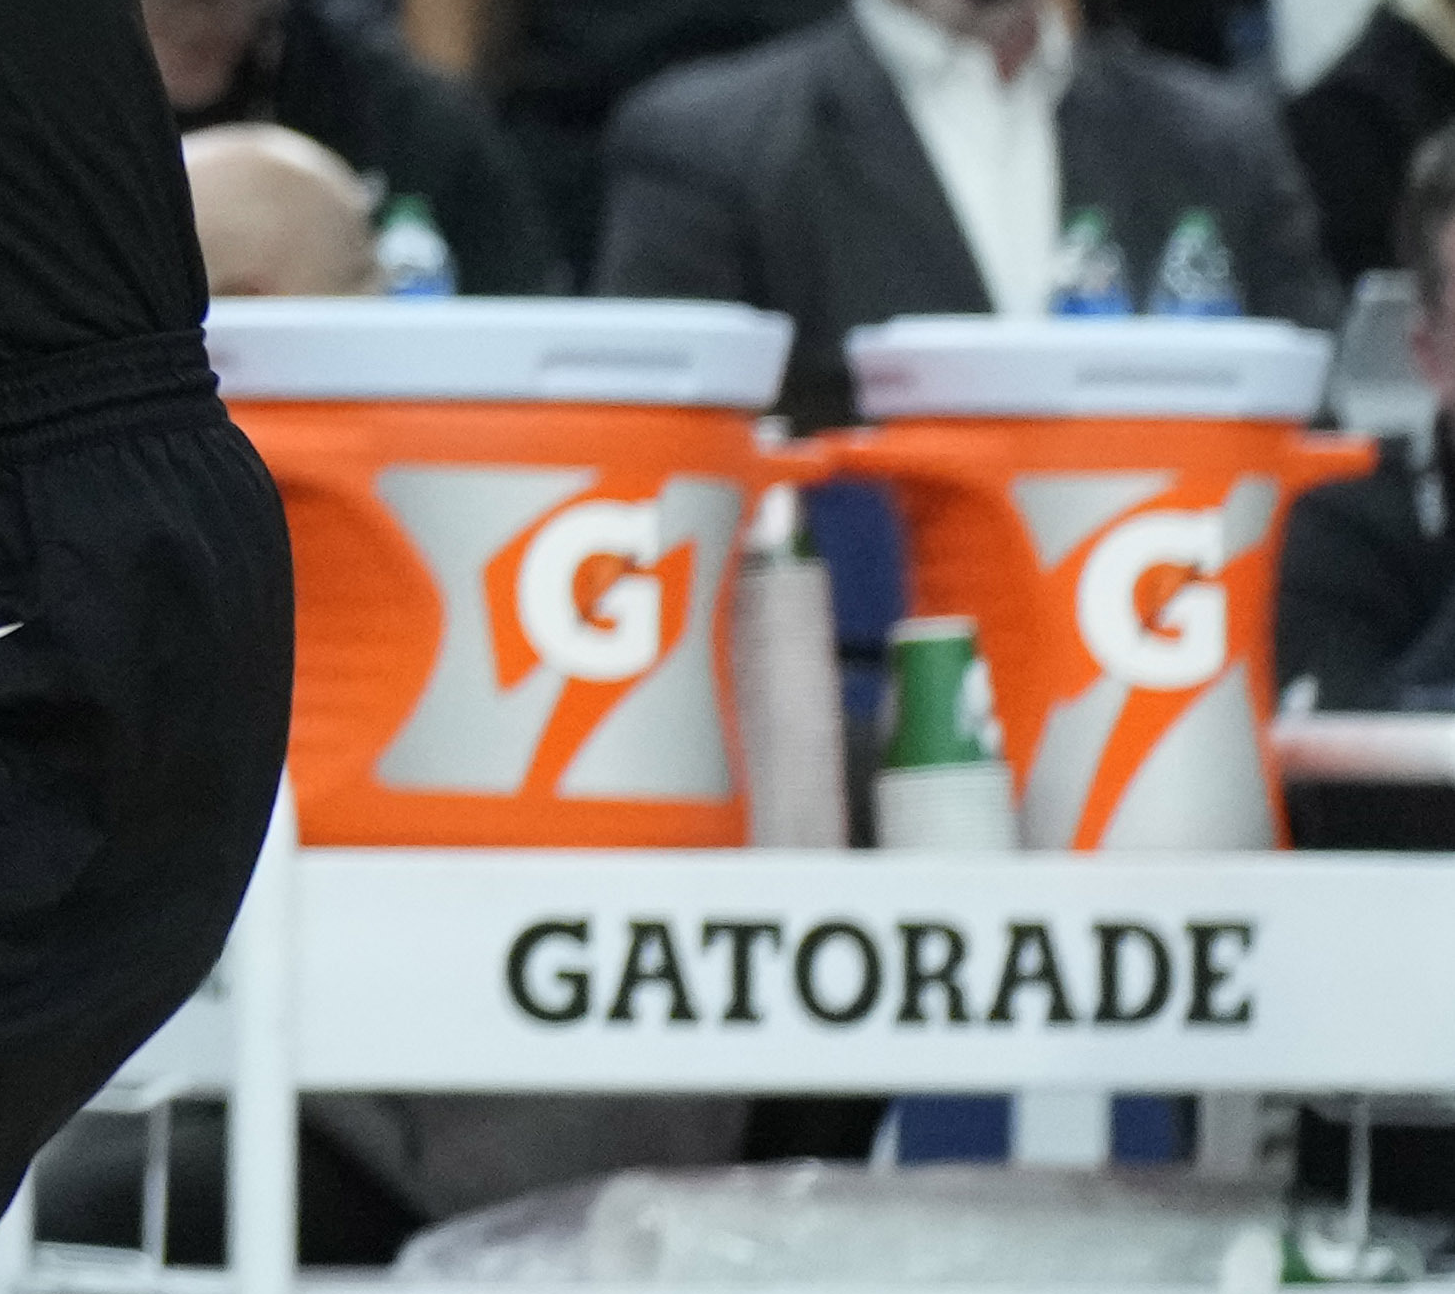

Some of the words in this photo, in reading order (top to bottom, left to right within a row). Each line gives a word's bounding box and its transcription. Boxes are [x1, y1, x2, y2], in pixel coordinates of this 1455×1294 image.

[515, 500, 663, 683] G
[1075, 512, 1228, 691] G
[504, 918, 1255, 1024] GATORADE
